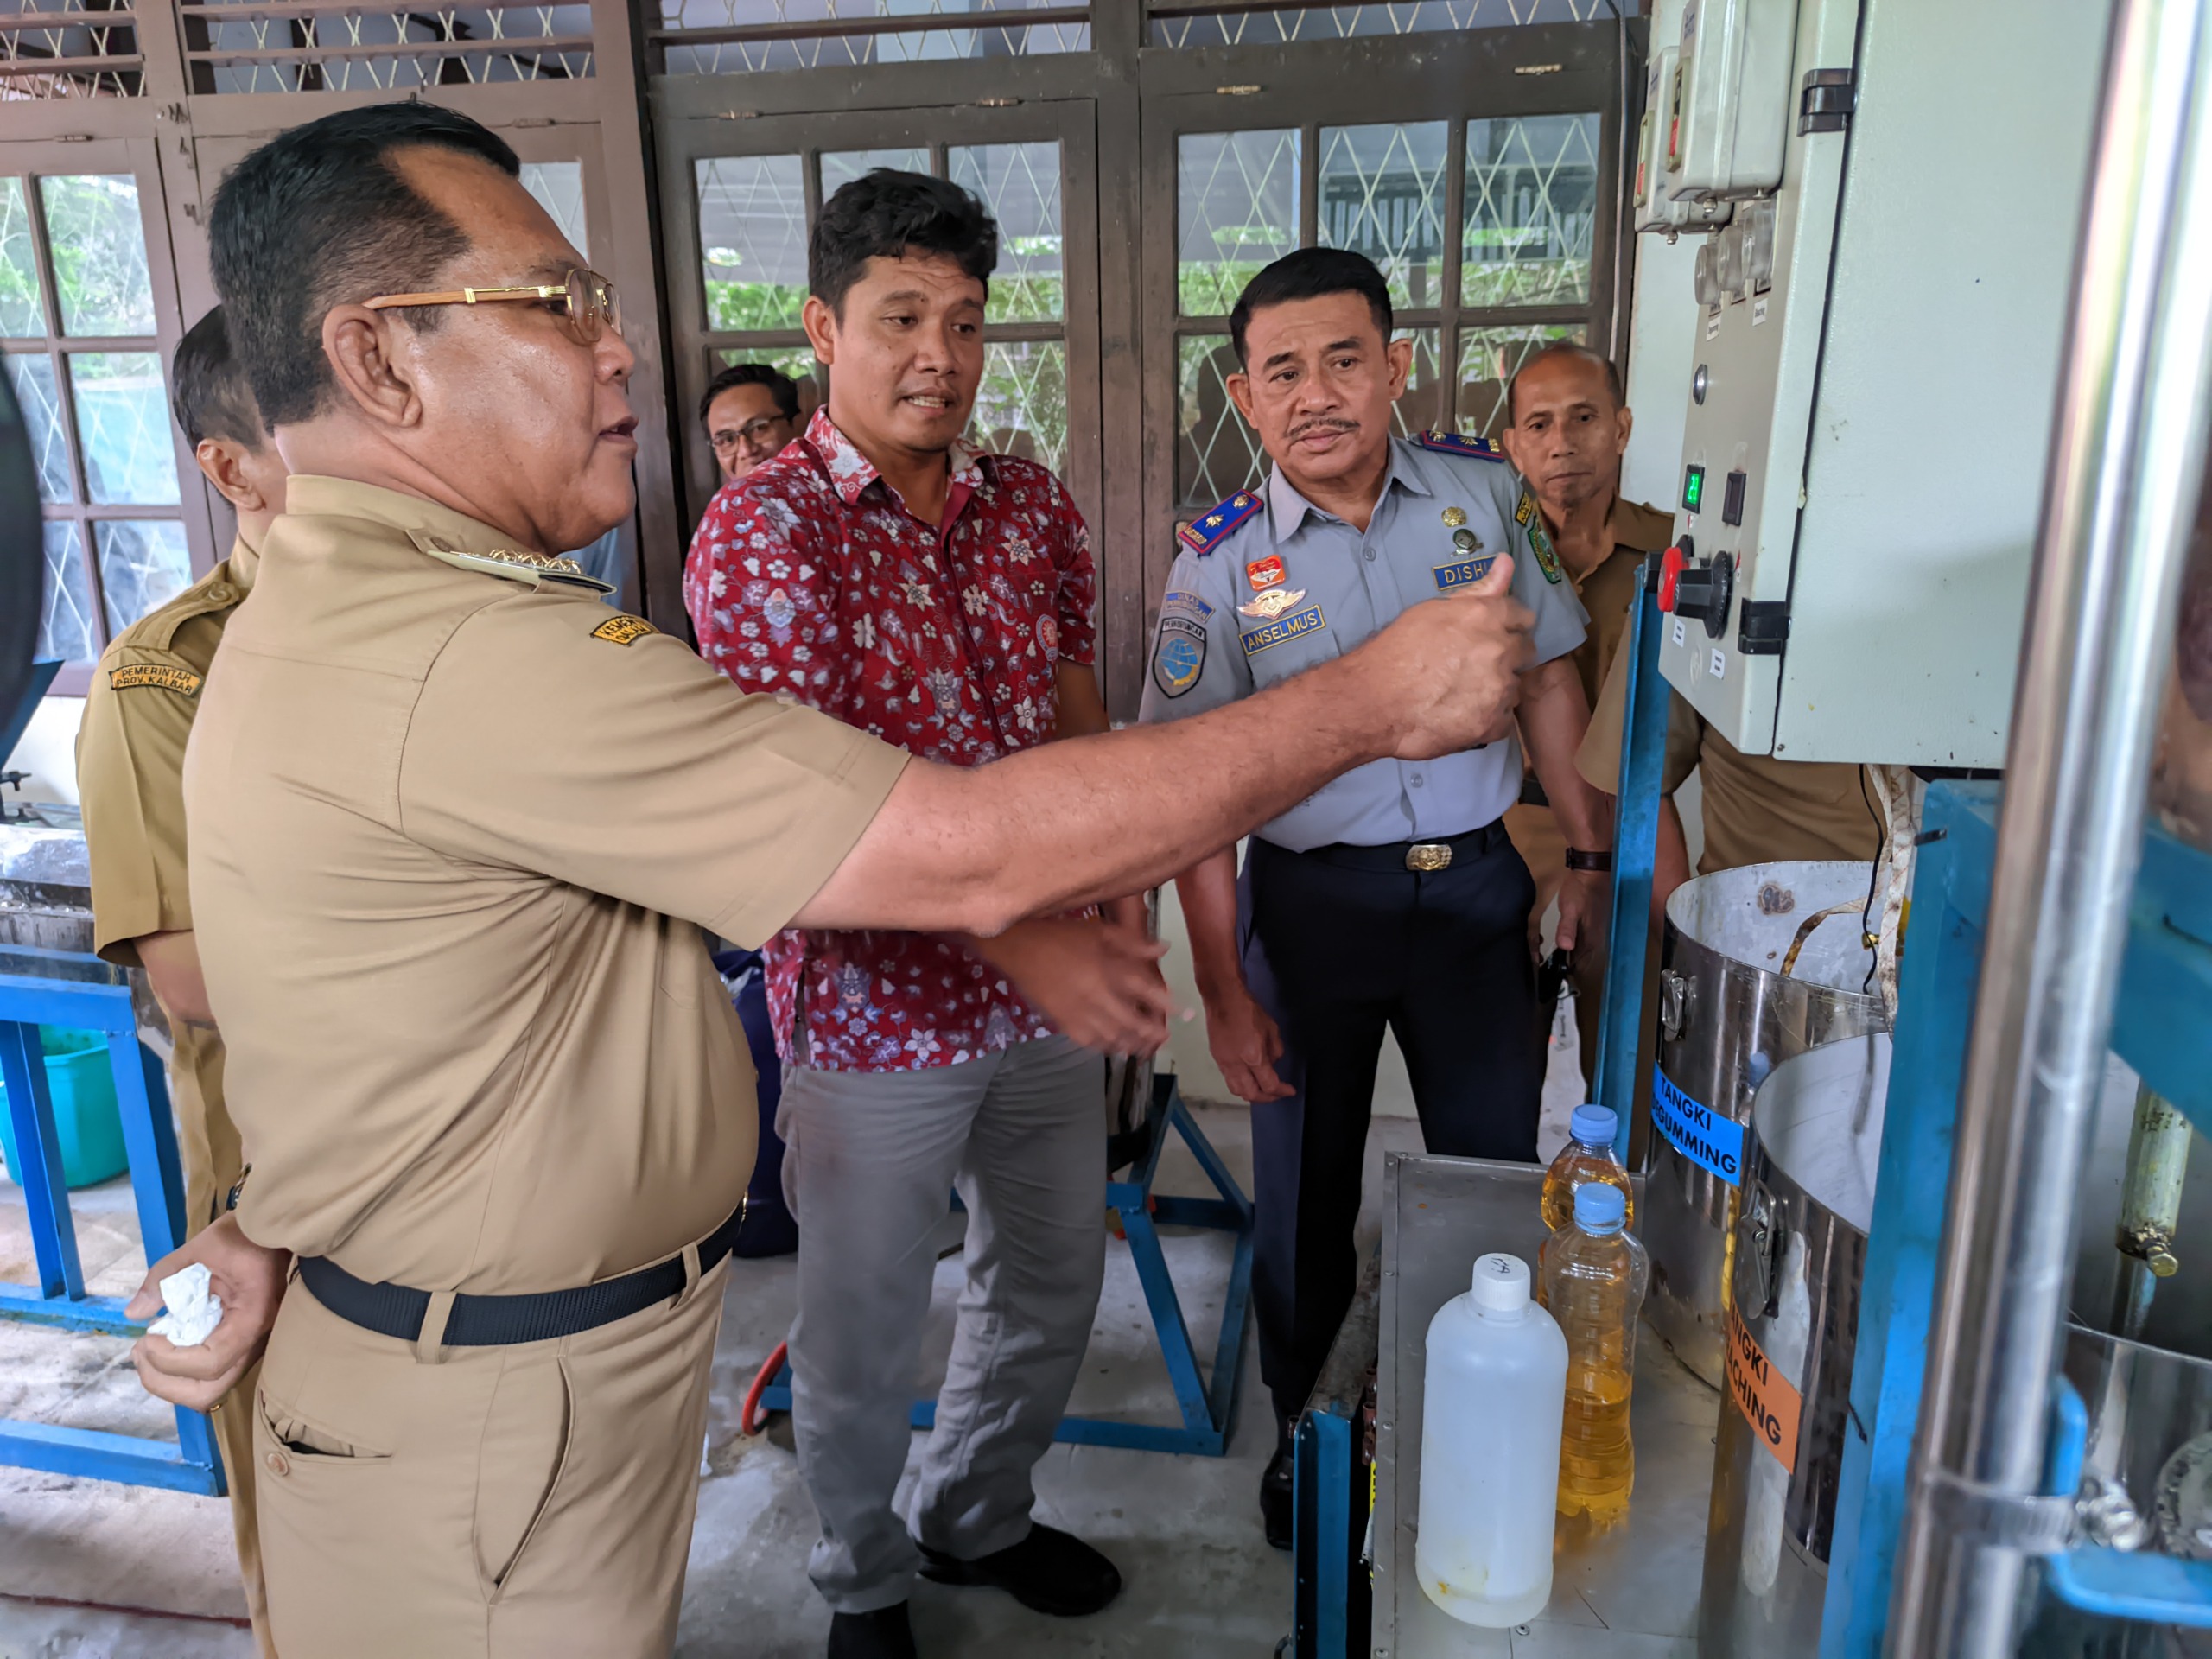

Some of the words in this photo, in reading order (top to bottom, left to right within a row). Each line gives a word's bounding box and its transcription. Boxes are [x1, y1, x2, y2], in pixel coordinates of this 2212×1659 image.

[1248, 613, 1319, 651] ANSELMUS
[117, 676, 146, 687] PROV.
[149, 676, 193, 694] KALBAR
[122, 666, 192, 683] PEMERINTAH
[1662, 1077, 1711, 1131] TANGKI
[1731, 1304, 1768, 1386] ANGKI
